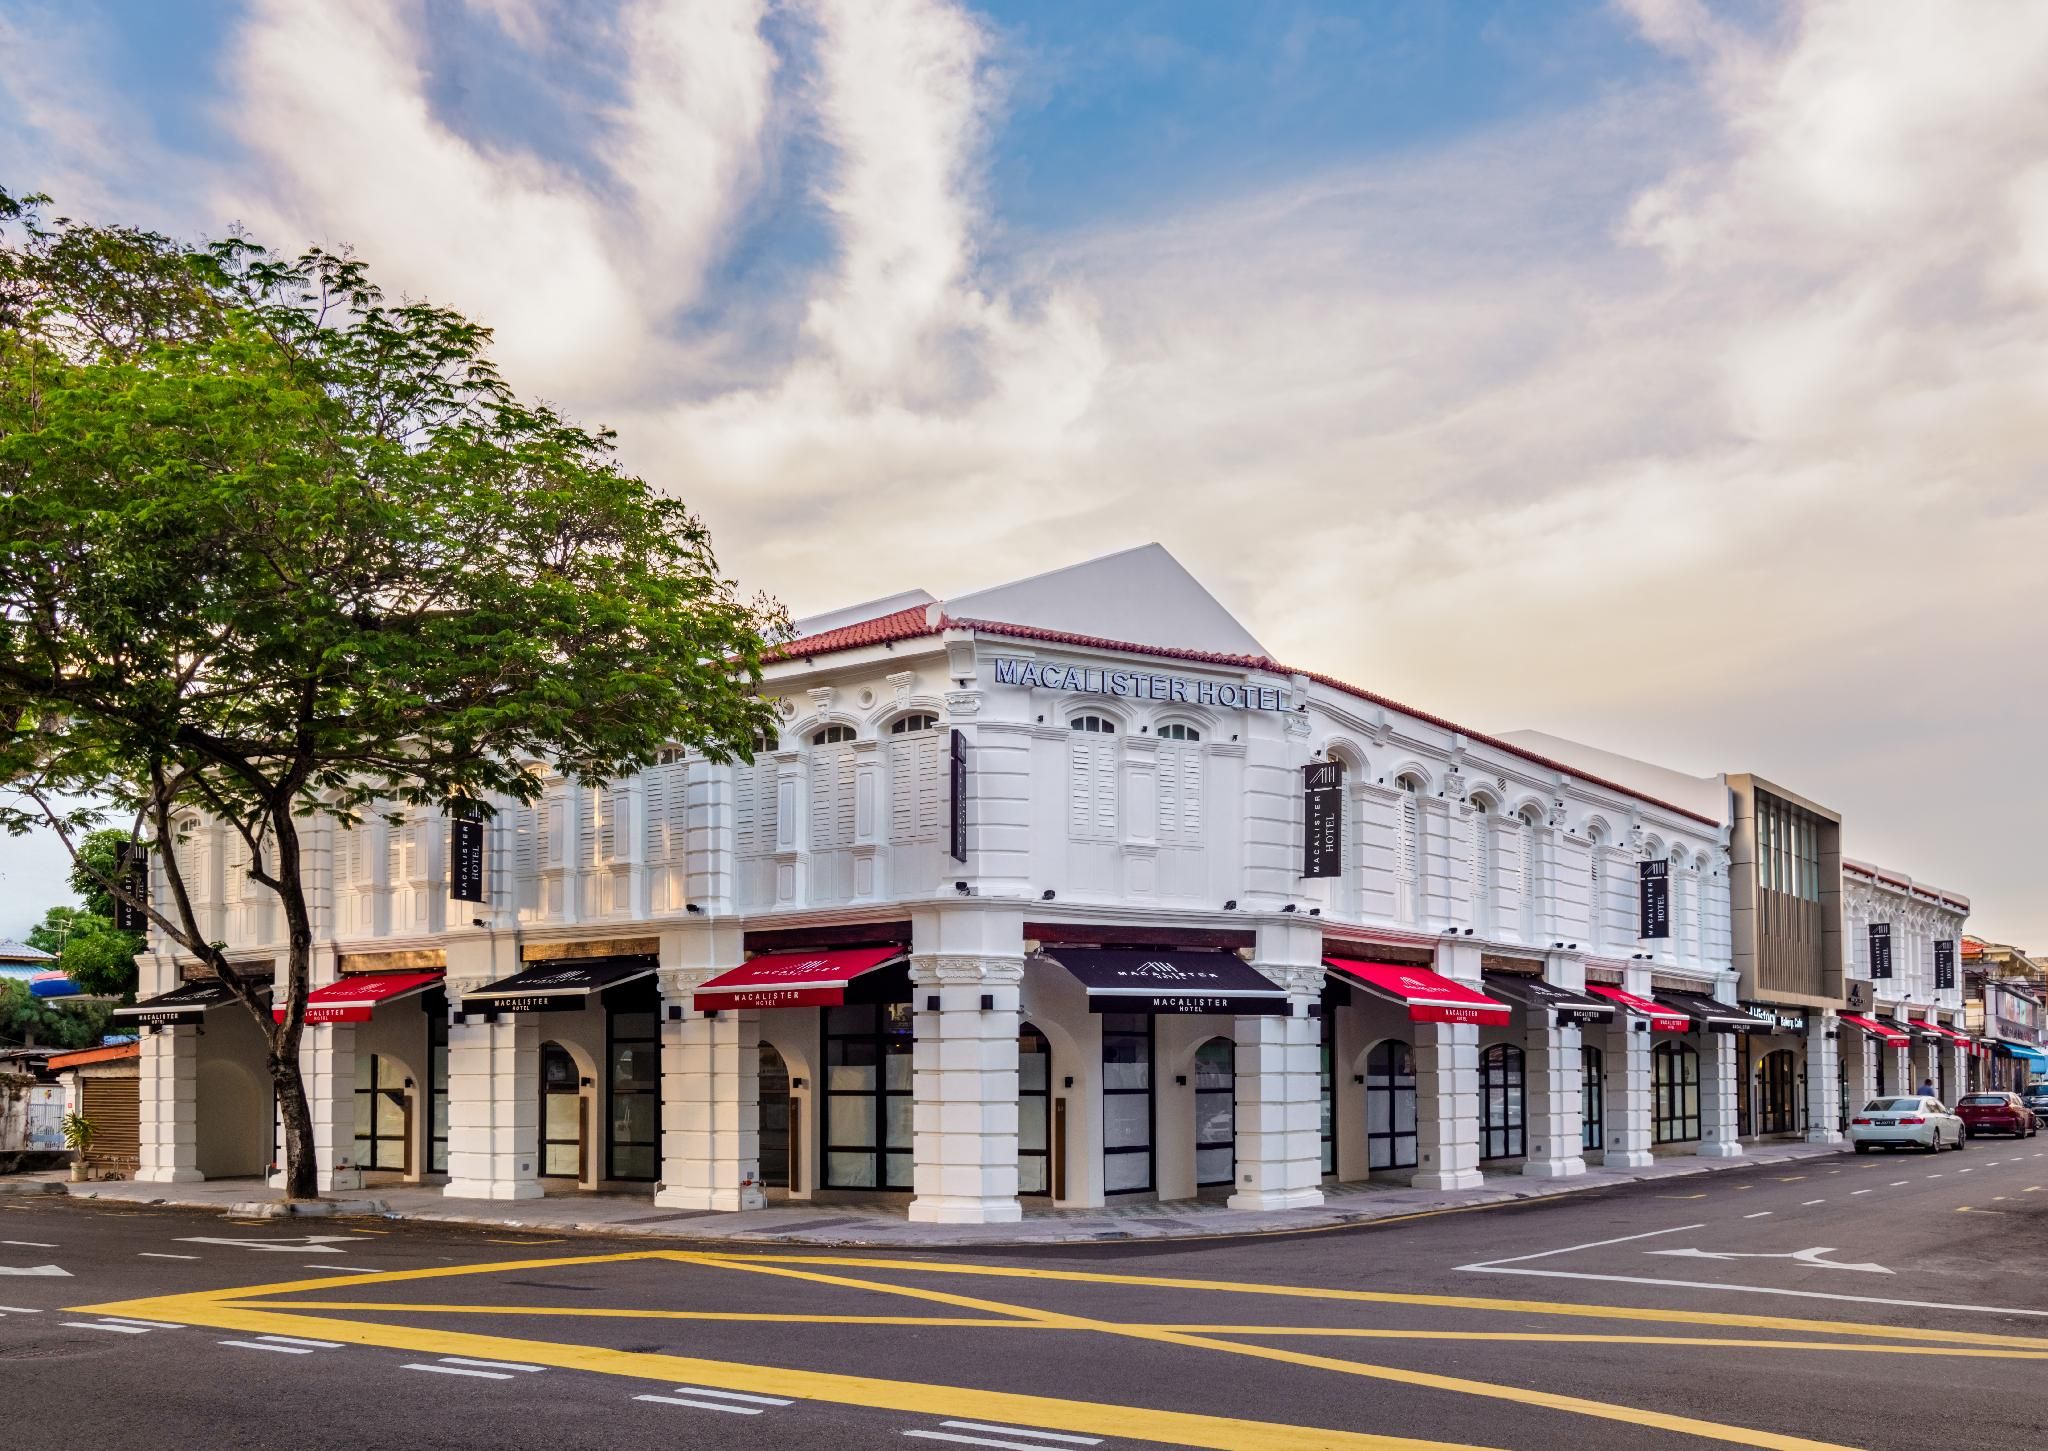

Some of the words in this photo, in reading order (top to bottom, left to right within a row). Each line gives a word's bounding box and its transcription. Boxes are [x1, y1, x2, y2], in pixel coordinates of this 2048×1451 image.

[994, 658, 1189, 702] MACALISTER
[1197, 681, 1291, 712] HOTEL
[1313, 795, 1321, 873] MACALISTER
[1325, 813, 1335, 853] HOTEL
[461, 825, 469, 896] MACALISTER
[471, 845, 480, 880] HOTEL
[1657, 894, 1665, 922] HOTEL
[494, 998, 549, 1007] MACALISTER
[734, 991, 799, 1001] MACALISTER
[1153, 998, 1228, 1007] MACALISTER
[305, 1009, 344, 1017] CALISTER
